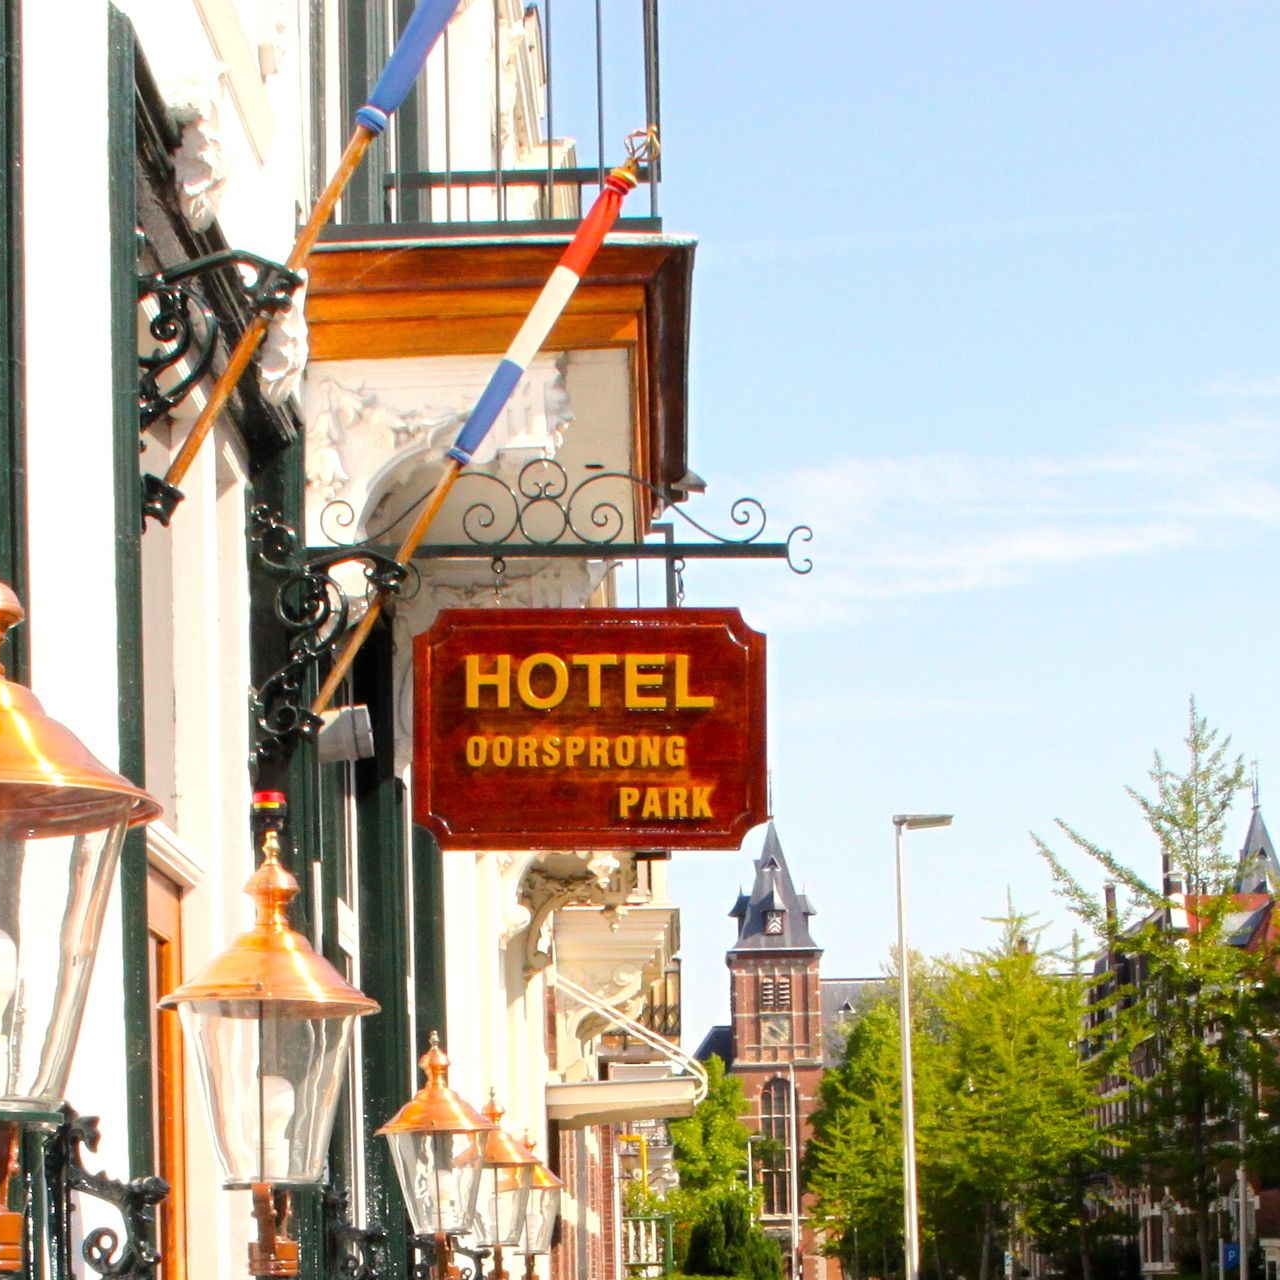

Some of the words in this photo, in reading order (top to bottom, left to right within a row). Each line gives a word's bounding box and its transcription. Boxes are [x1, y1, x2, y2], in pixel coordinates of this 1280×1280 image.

[465, 652, 715, 710] HOTEL
[465, 735, 687, 768] OORSPRONG
[619, 786, 715, 818] PARK
